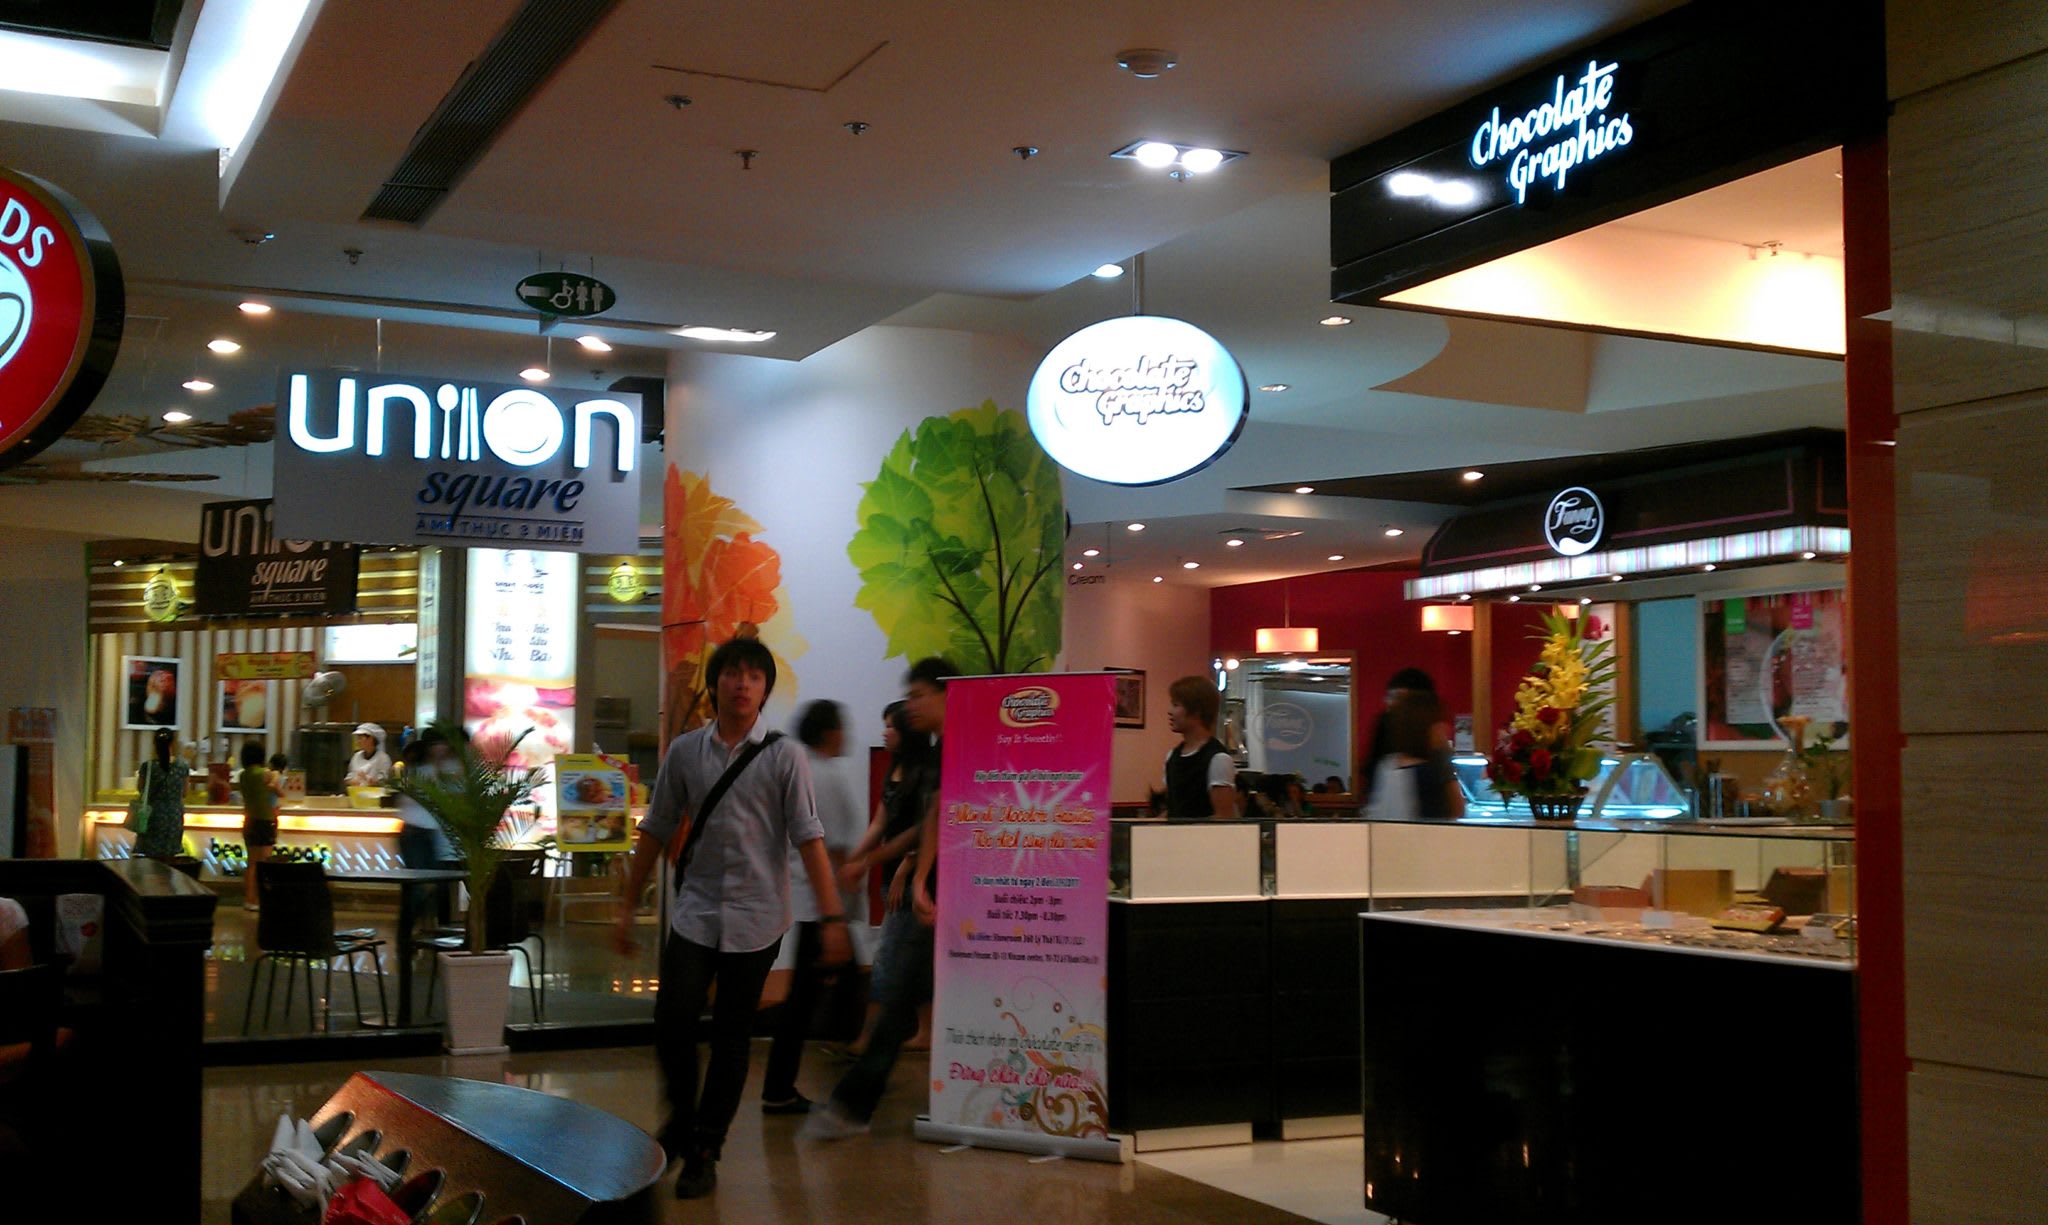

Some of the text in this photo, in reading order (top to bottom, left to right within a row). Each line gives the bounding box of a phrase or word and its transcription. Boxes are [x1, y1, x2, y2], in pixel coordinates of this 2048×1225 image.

[1472, 60, 1619, 165] Chocolate
[1509, 112, 1633, 204] Graphics
[1060, 354, 1198, 395] Chocolate
[1096, 389, 1206, 426] Graphics
[418, 470, 584, 529] square
[250, 557, 329, 602] square
